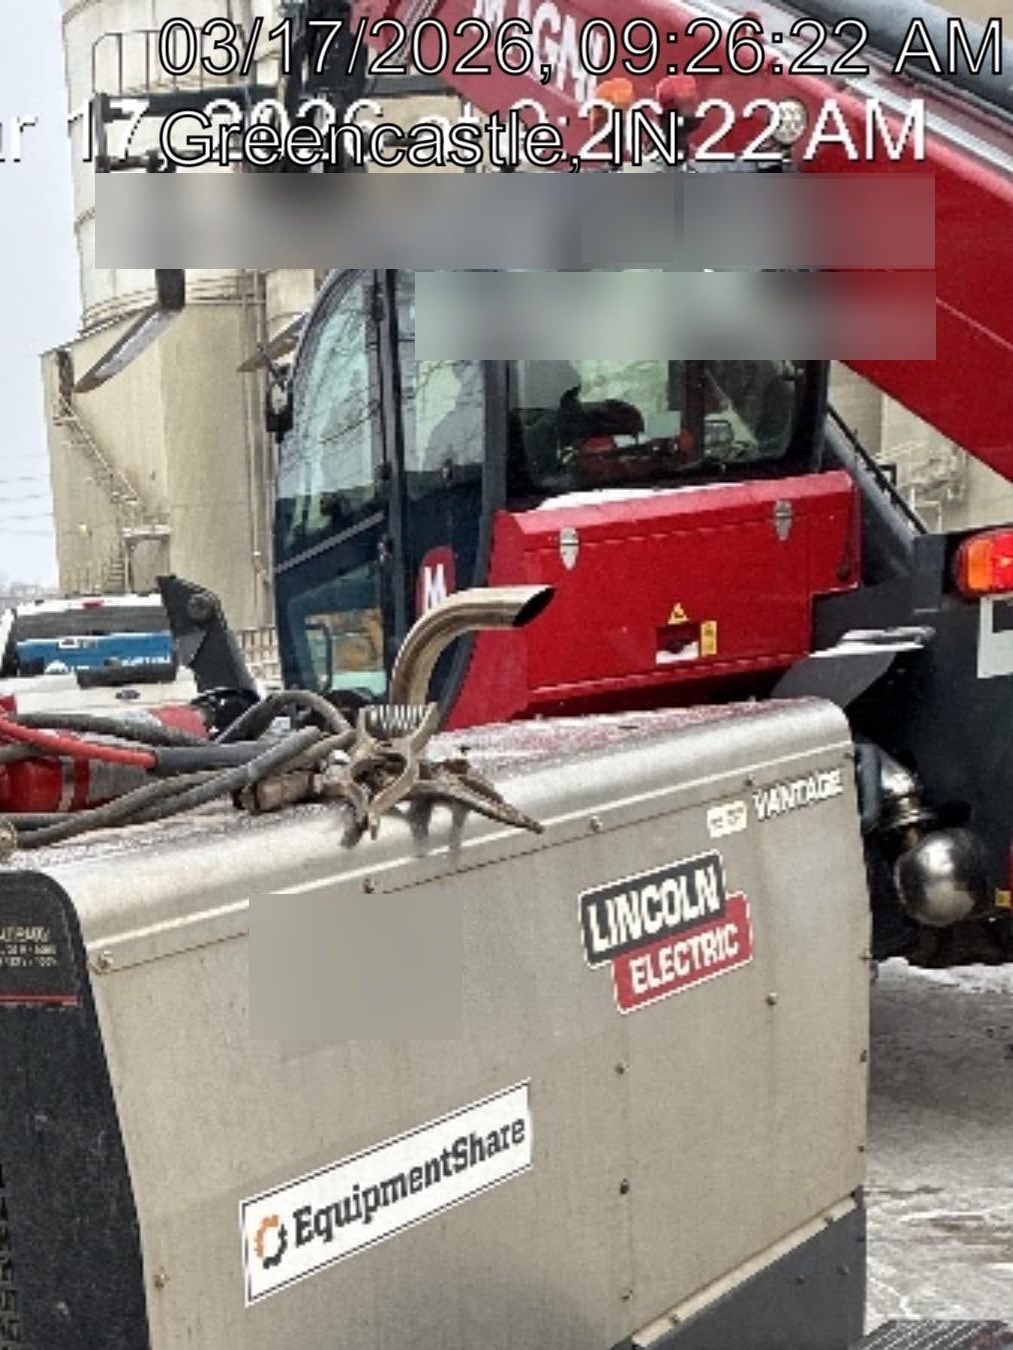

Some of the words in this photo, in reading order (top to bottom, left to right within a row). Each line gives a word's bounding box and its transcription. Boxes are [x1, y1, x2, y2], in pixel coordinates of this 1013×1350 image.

[752, 768, 845, 821] VANTAGE
[587, 864, 721, 953] LINCOLN
[629, 922, 739, 994] ELECTRIC
[292, 1117, 527, 1248] EquipmentShare
